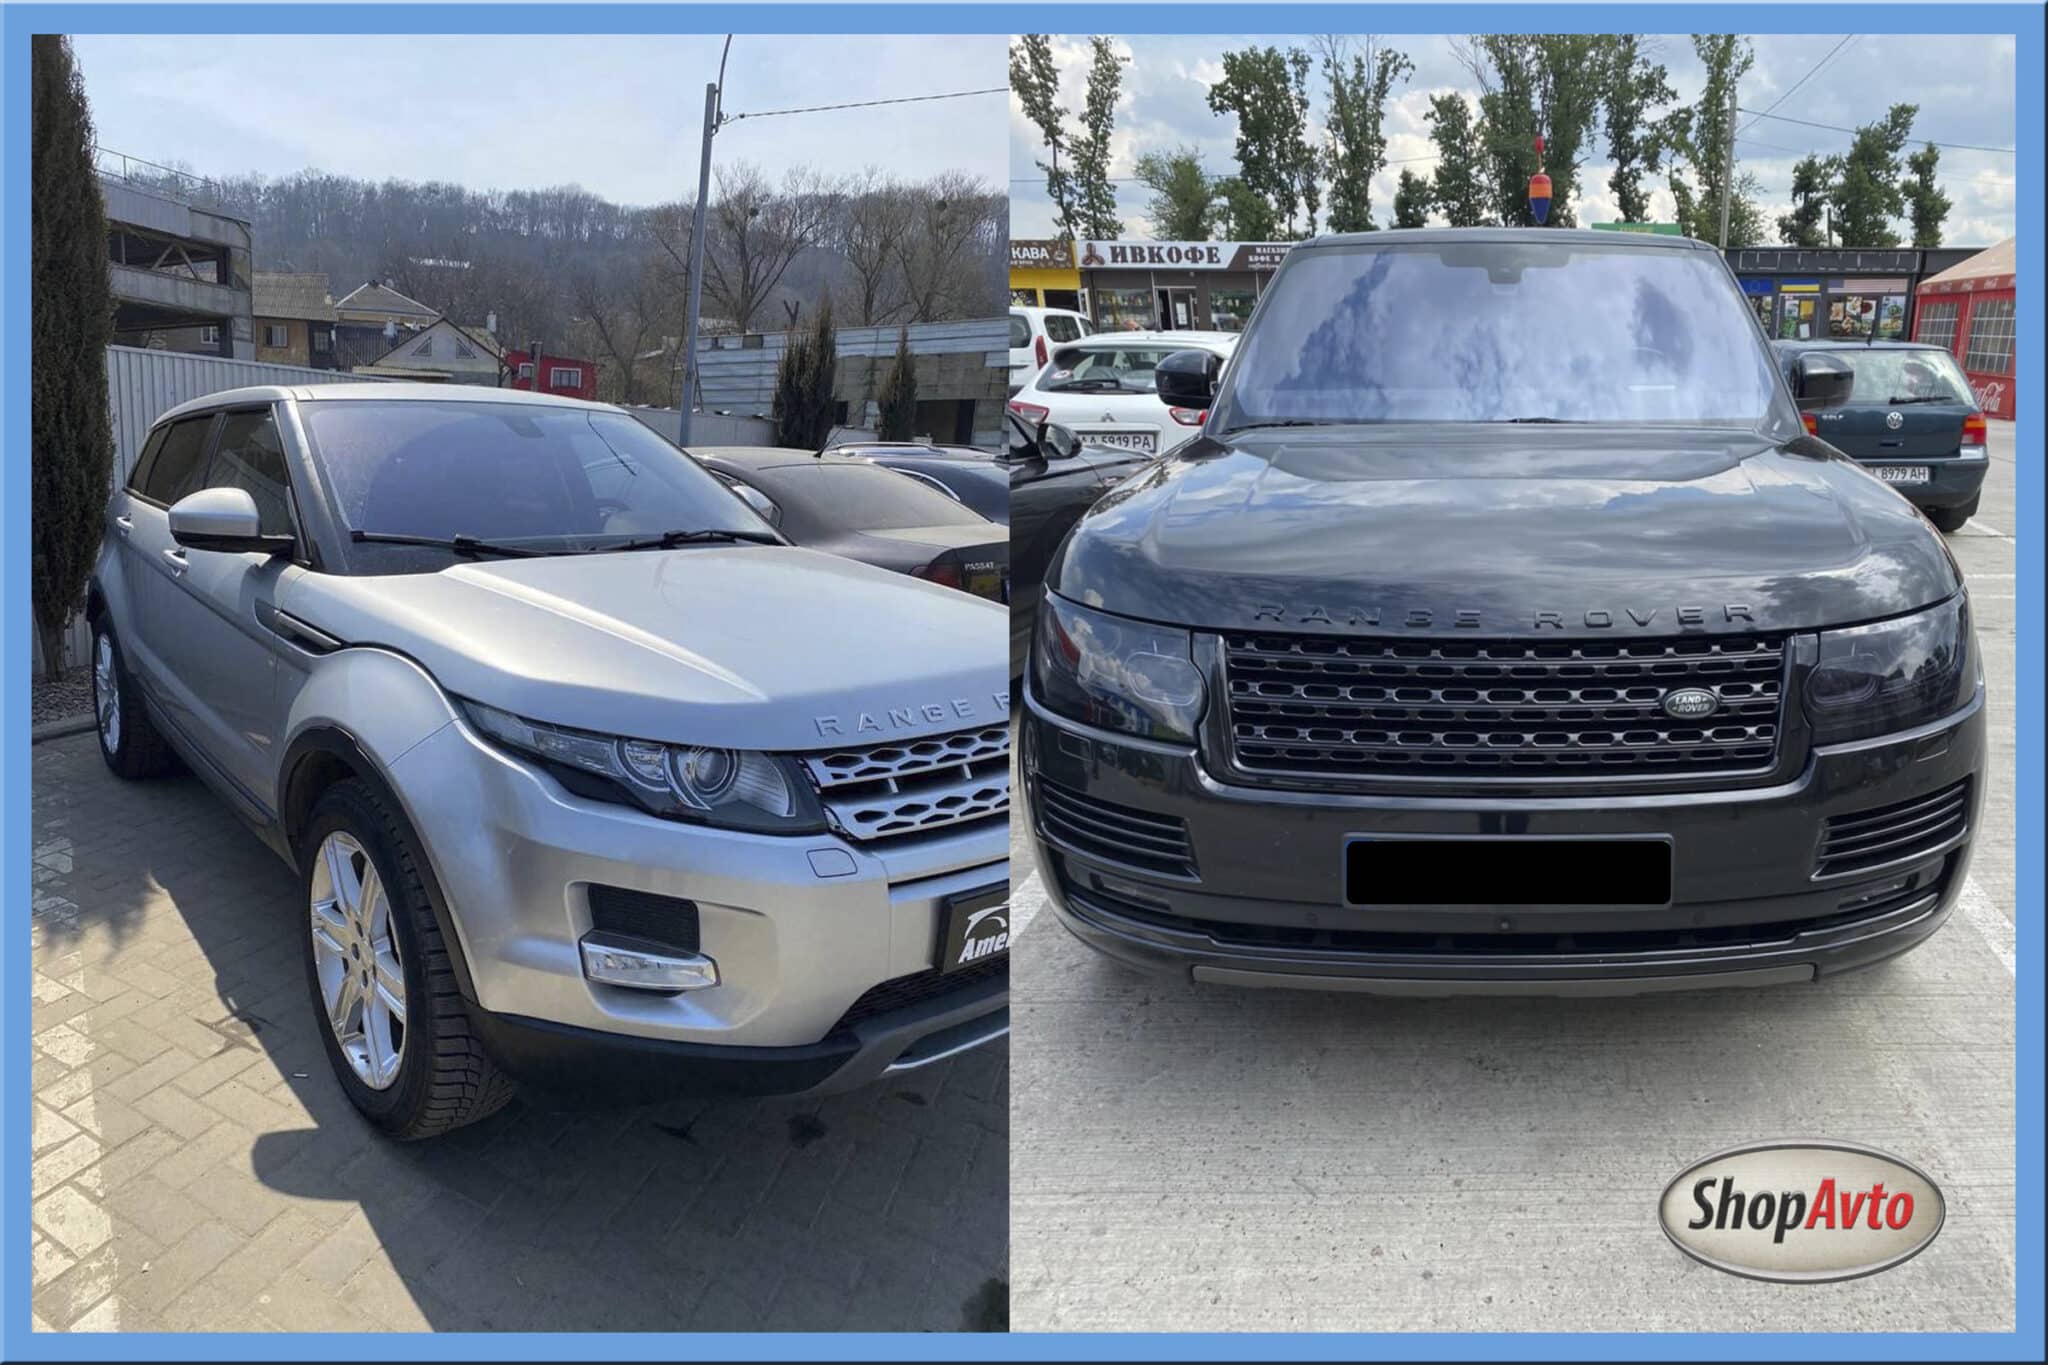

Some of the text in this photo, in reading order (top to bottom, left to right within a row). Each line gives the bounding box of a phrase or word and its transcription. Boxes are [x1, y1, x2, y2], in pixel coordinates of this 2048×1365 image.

[1109, 245, 1221, 264] ИВКОФЕ
[1881, 467, 1908, 480] 8979
[1254, 603, 1755, 630] RANGE ROVER
[1675, 695, 1701, 704] LAND
[1678, 703, 1710, 712] ROVER
[813, 698, 977, 737] RANGE
